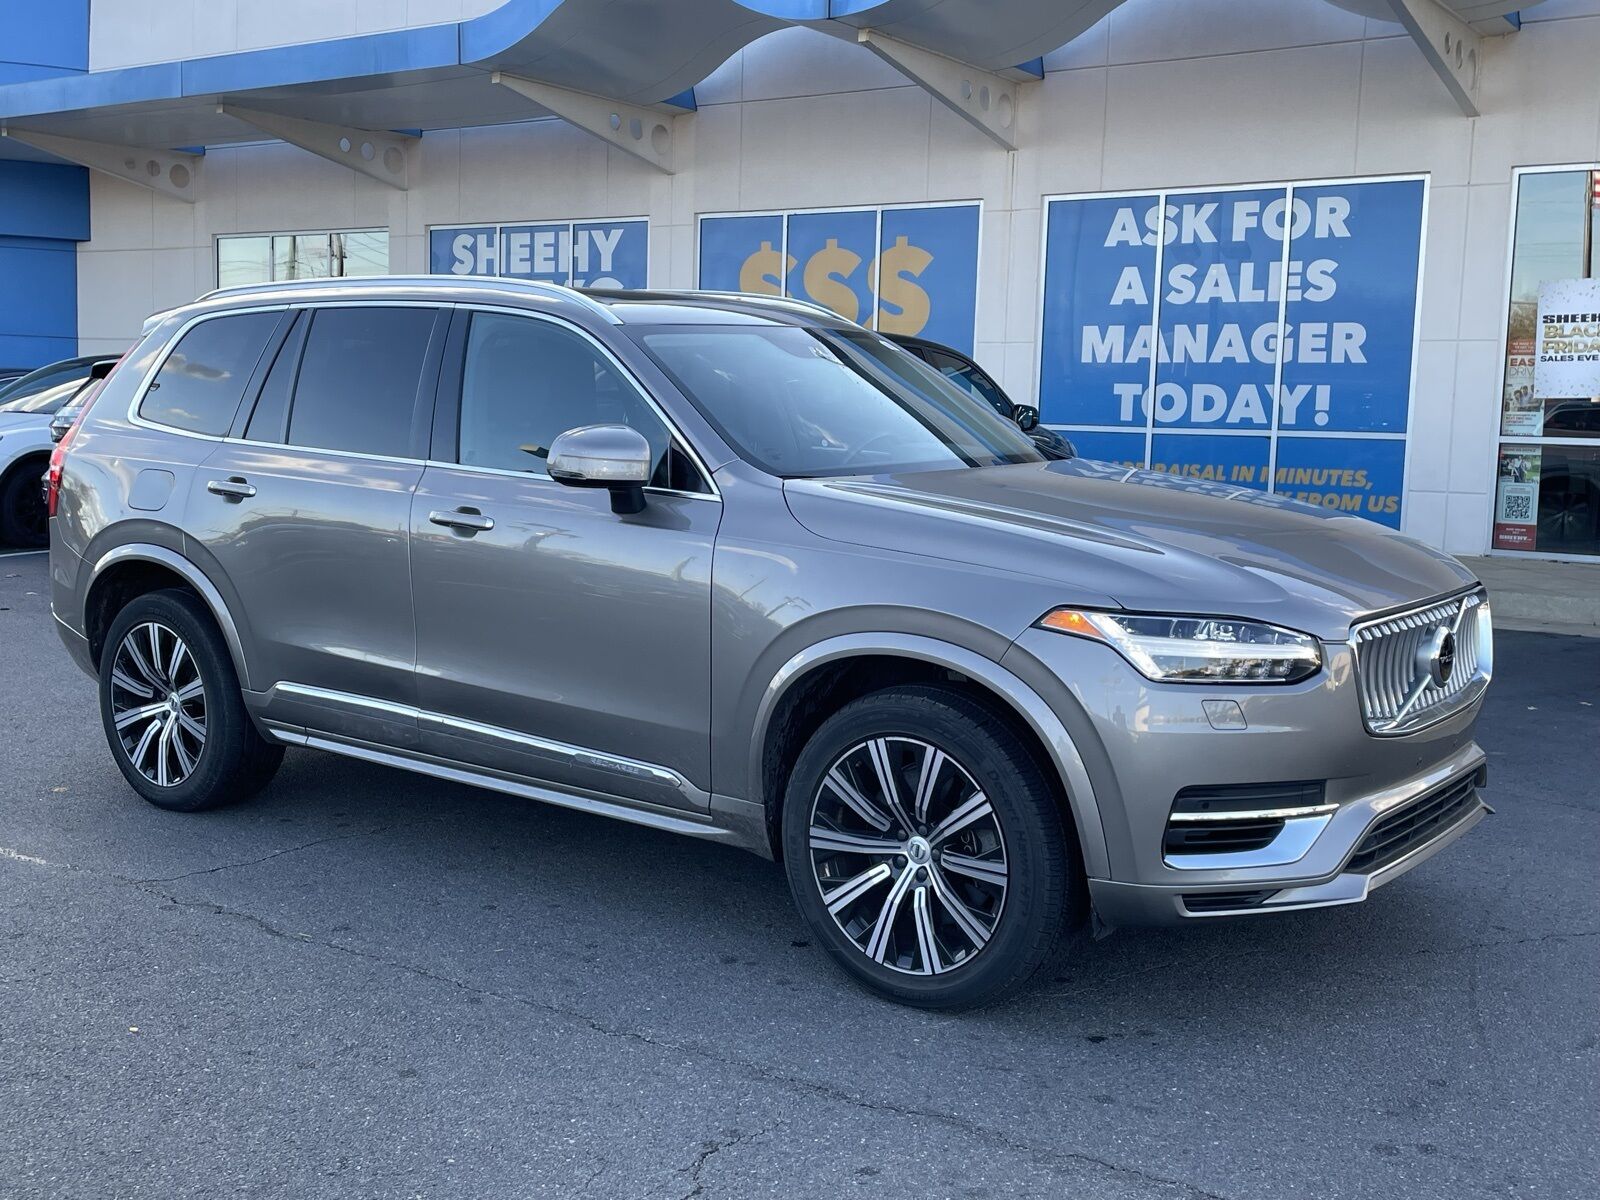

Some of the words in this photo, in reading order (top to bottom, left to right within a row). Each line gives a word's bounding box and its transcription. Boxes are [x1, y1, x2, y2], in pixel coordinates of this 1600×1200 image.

[1103, 203, 1218, 247] ASK
[1232, 196, 1351, 242] FOR
[451, 229, 624, 275] SHEEHY
[1109, 266, 1149, 305] A
[1165, 259, 1339, 304] SALES
[1080, 322, 1368, 364] MANAGER
[1544, 323, 1600, 338] BLAC
[1113, 382, 1331, 427] TODAY!
[1112, 461, 1226, 481] RAISAL
[1231, 465, 1255, 482] IN
[1259, 465, 1374, 490] MINUTES,
[1367, 495, 1400, 514] US
